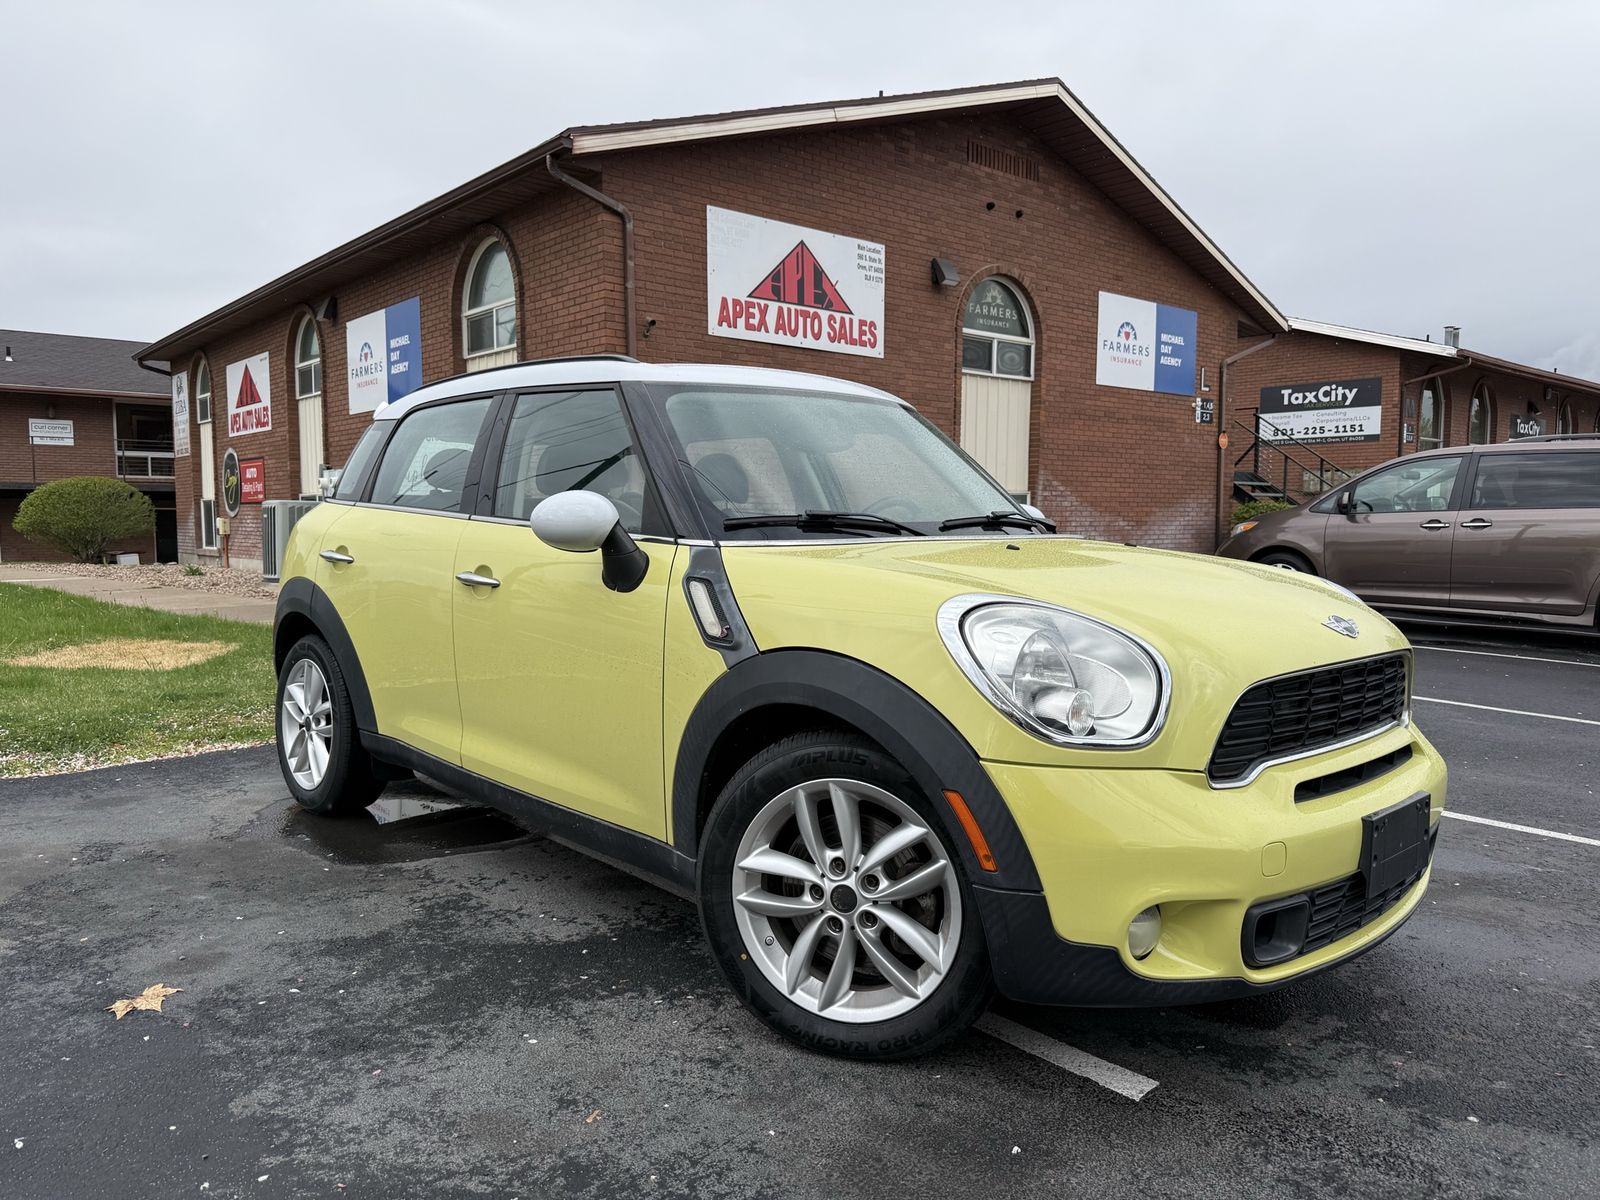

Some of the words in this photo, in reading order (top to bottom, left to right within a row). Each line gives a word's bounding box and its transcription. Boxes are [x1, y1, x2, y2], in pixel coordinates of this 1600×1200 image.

[857, 243, 865, 251] Main
[868, 255, 877, 264] State
[868, 264, 873, 272] UT
[969, 303, 1018, 320] FARMERS
[717, 296, 770, 333] APEX
[774, 305, 823, 341] AUTO
[827, 313, 878, 349] SALES
[976, 318, 1009, 328] INSURANCE
[390, 335, 411, 349] MICHAEL
[1160, 333, 1185, 346] MICHAEL
[1103, 339, 1150, 357] FARMERS
[1160, 344, 1173, 354] DAY
[390, 350, 400, 362] DAY
[1110, 356, 1142, 366] INSURANCE
[1160, 355, 1182, 367] AGENCY
[351, 361, 383, 380] FARMERS
[391, 361, 409, 375] AGENCY
[356, 378, 378, 389] INSURANCE
[1201, 367, 1210, 391] L
[1281, 384, 1358, 406] TaxCity
[231, 412, 241, 434] APEX
[242, 408, 254, 432] AUTO
[254, 405, 270, 428] SALES
[1273, 424, 1364, 437] 801-225-1151
[1516, 418, 1540, 437] TaxCity
[246, 467, 257, 478] AUTO
[791, 748, 869, 768] APLUS
[789, 1024, 870, 1052] RACING
[878, 1028, 924, 1051] PRO
